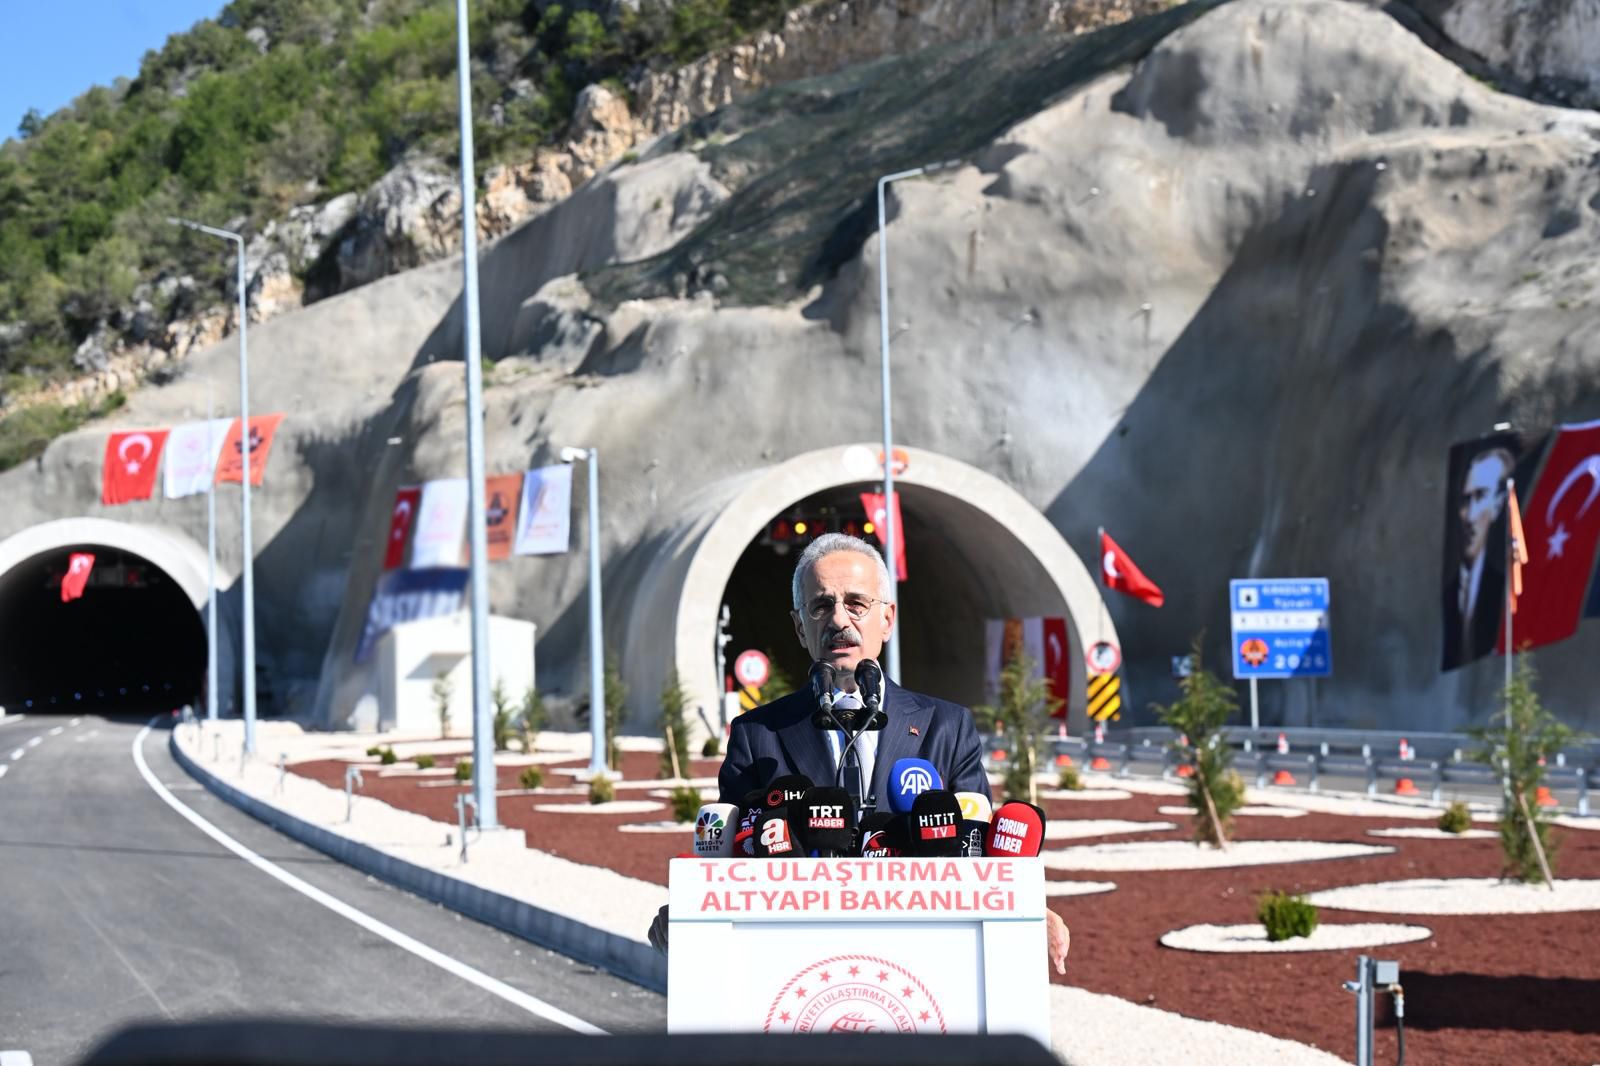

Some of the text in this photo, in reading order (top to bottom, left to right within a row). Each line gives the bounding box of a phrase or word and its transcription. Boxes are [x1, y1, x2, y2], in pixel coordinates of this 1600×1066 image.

[809, 806, 844, 818] TRT
[809, 818, 843, 827] HABER
[996, 817, 1029, 838] ÇORUM
[707, 828, 723, 840] 19
[931, 828, 949, 838] TV
[768, 842, 790, 854] HBR
[993, 833, 1023, 855] HABER
[700, 861, 1014, 887] T.C. ULAŞTIRMA VE
[700, 886, 1015, 912] ALTYAPI BAKANLIĞI
[799, 987, 900, 1033] RİYETİ ULAŞTIRMA VE
